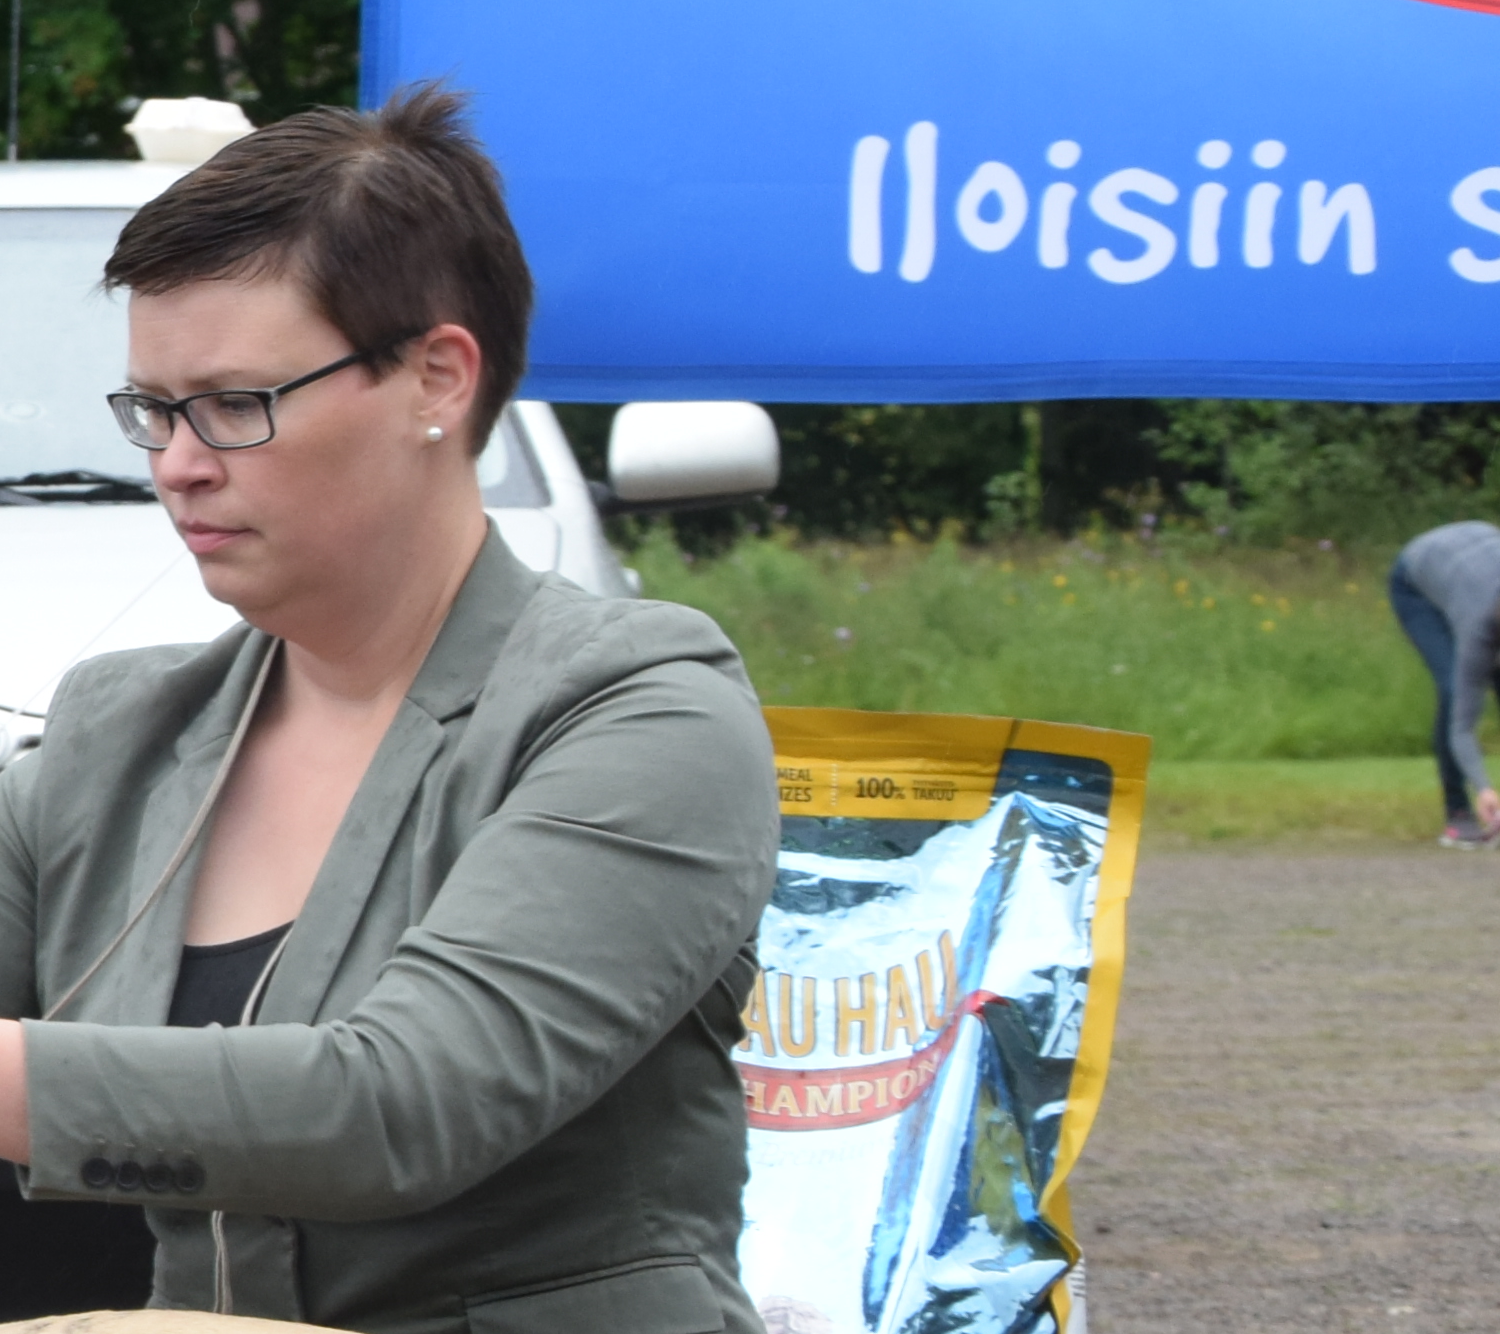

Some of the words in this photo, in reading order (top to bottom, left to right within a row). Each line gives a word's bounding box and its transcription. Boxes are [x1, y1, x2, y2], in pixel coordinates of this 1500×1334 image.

[848, 119, 1377, 283] Iloisiin
[778, 786, 813, 803] IZES
[855, 776, 906, 800] 100%
[738, 966, 817, 1058] AU
[833, 928, 958, 1058] HAU
[743, 1047, 943, 1118] HAMPION
